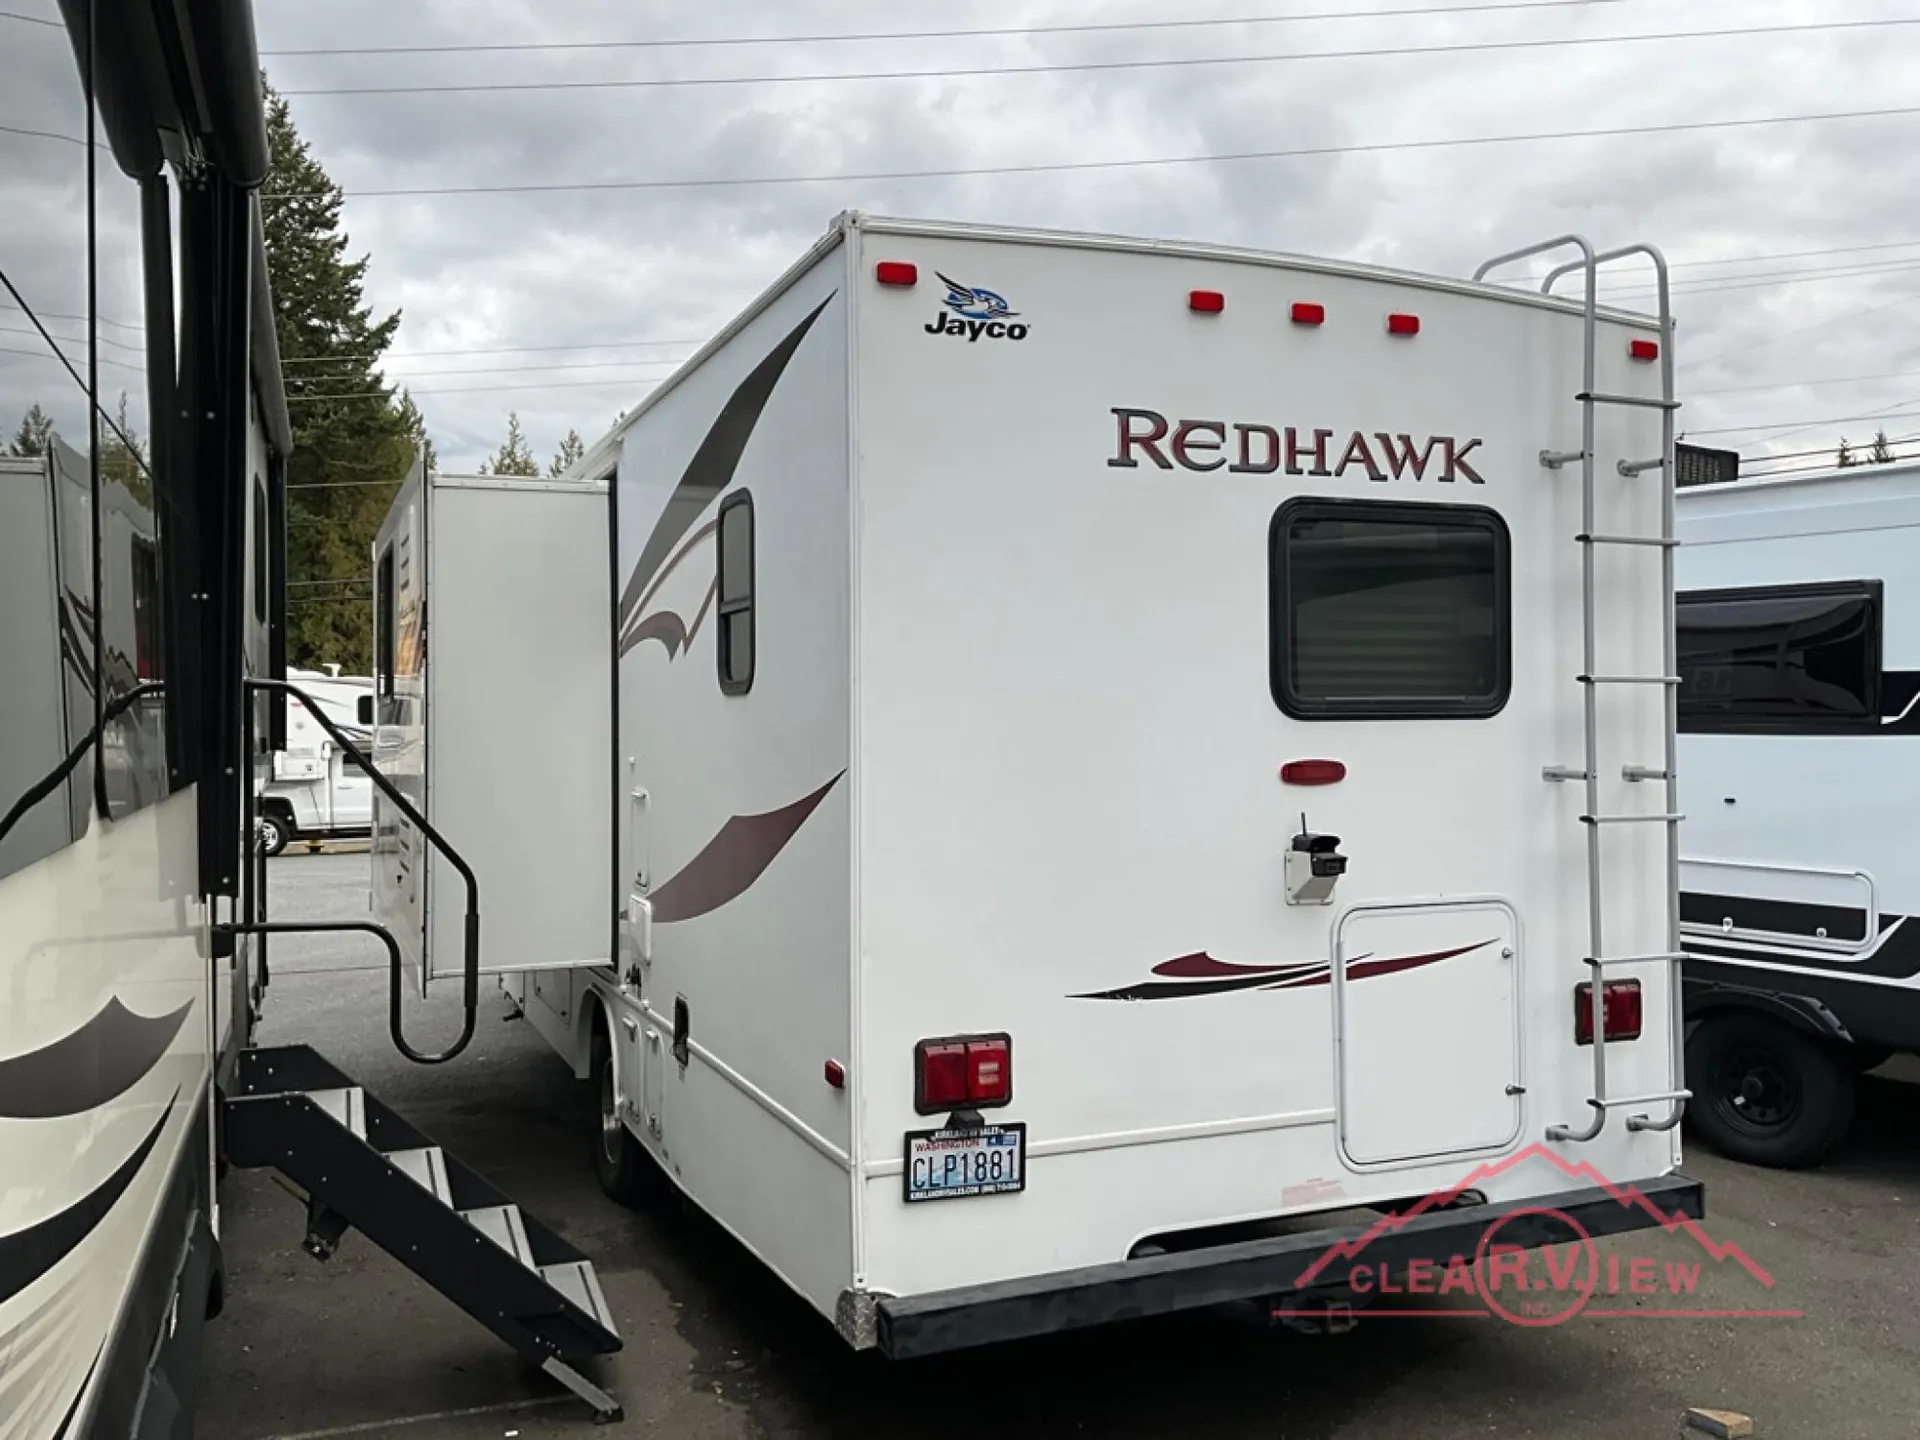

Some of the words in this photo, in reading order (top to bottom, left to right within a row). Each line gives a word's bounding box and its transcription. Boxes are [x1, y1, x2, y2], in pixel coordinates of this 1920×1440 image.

[924, 311, 1028, 342] Jayco
[1107, 407, 1486, 484] REDHAWK
[914, 1138, 981, 1152] WASHINGTON
[912, 1148, 1015, 1189] CLP1881
